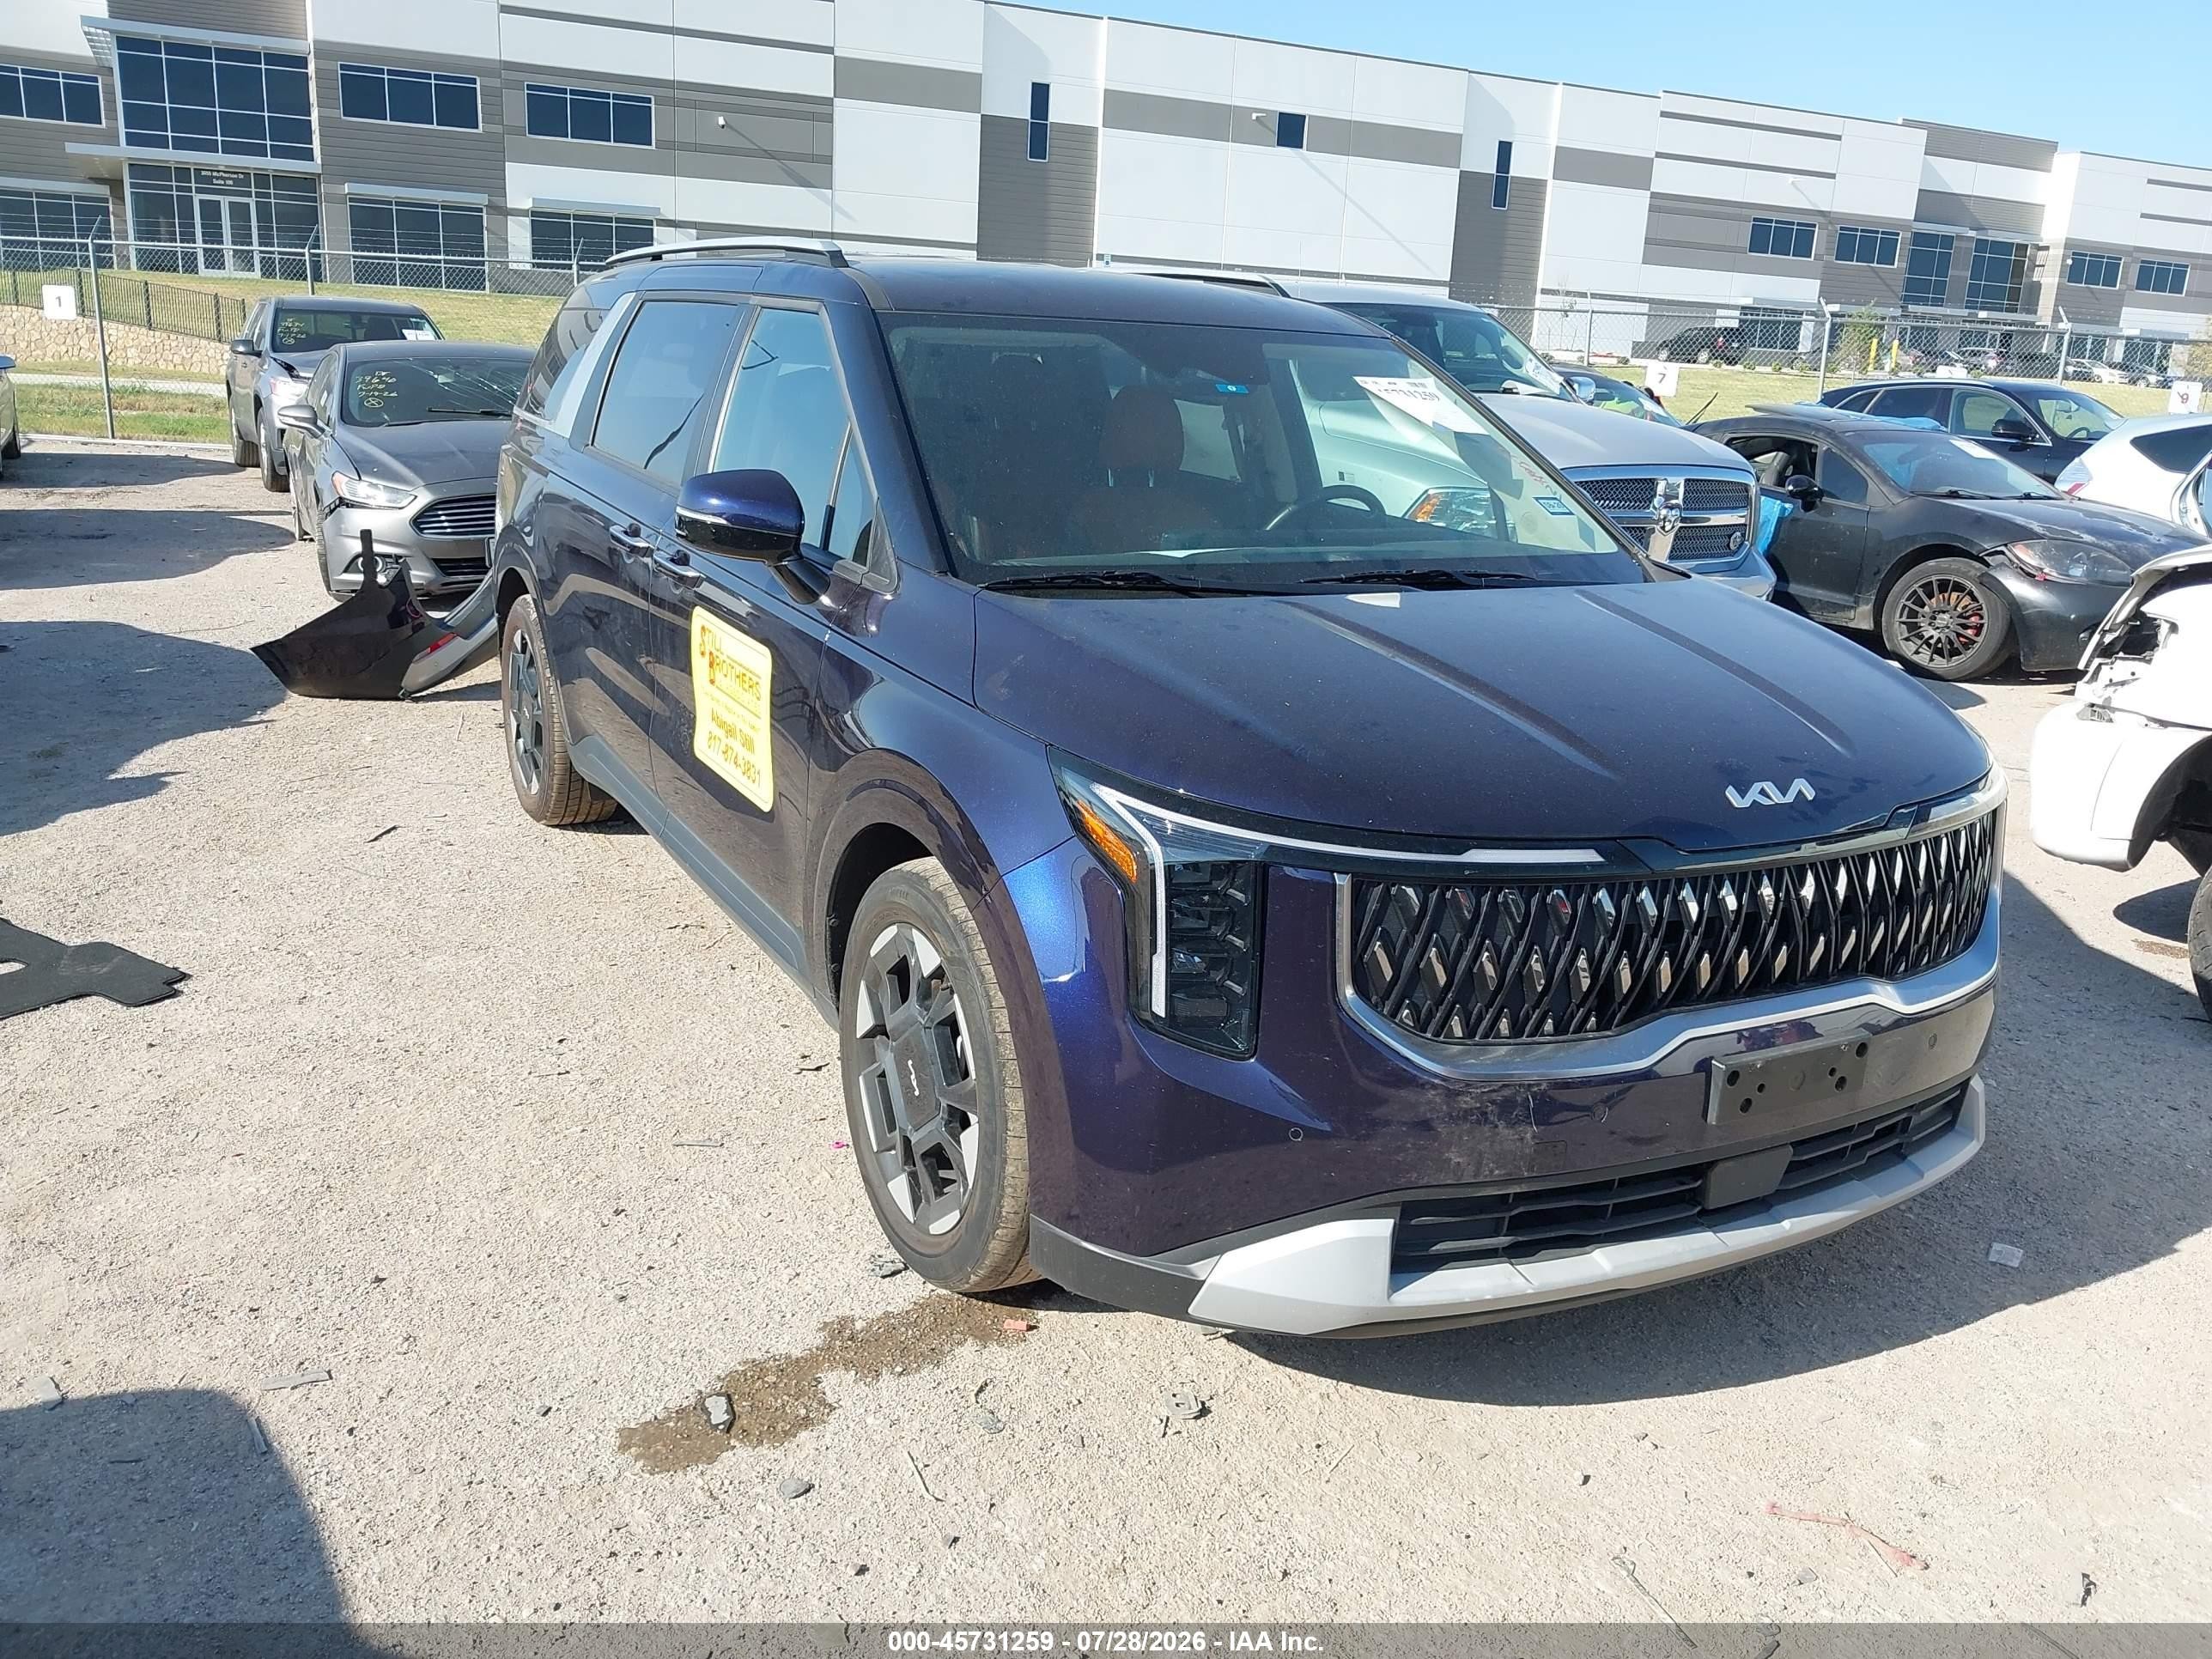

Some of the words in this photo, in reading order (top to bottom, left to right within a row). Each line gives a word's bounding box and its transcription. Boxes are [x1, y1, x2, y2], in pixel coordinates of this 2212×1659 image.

[55, 295, 62, 308] 1
[1657, 372, 1667, 384] 7
[699, 624, 725, 658] STILL
[708, 651, 762, 702] BROTHERS
[711, 707, 738, 742] Abigail
[739, 730, 756, 756] Still
